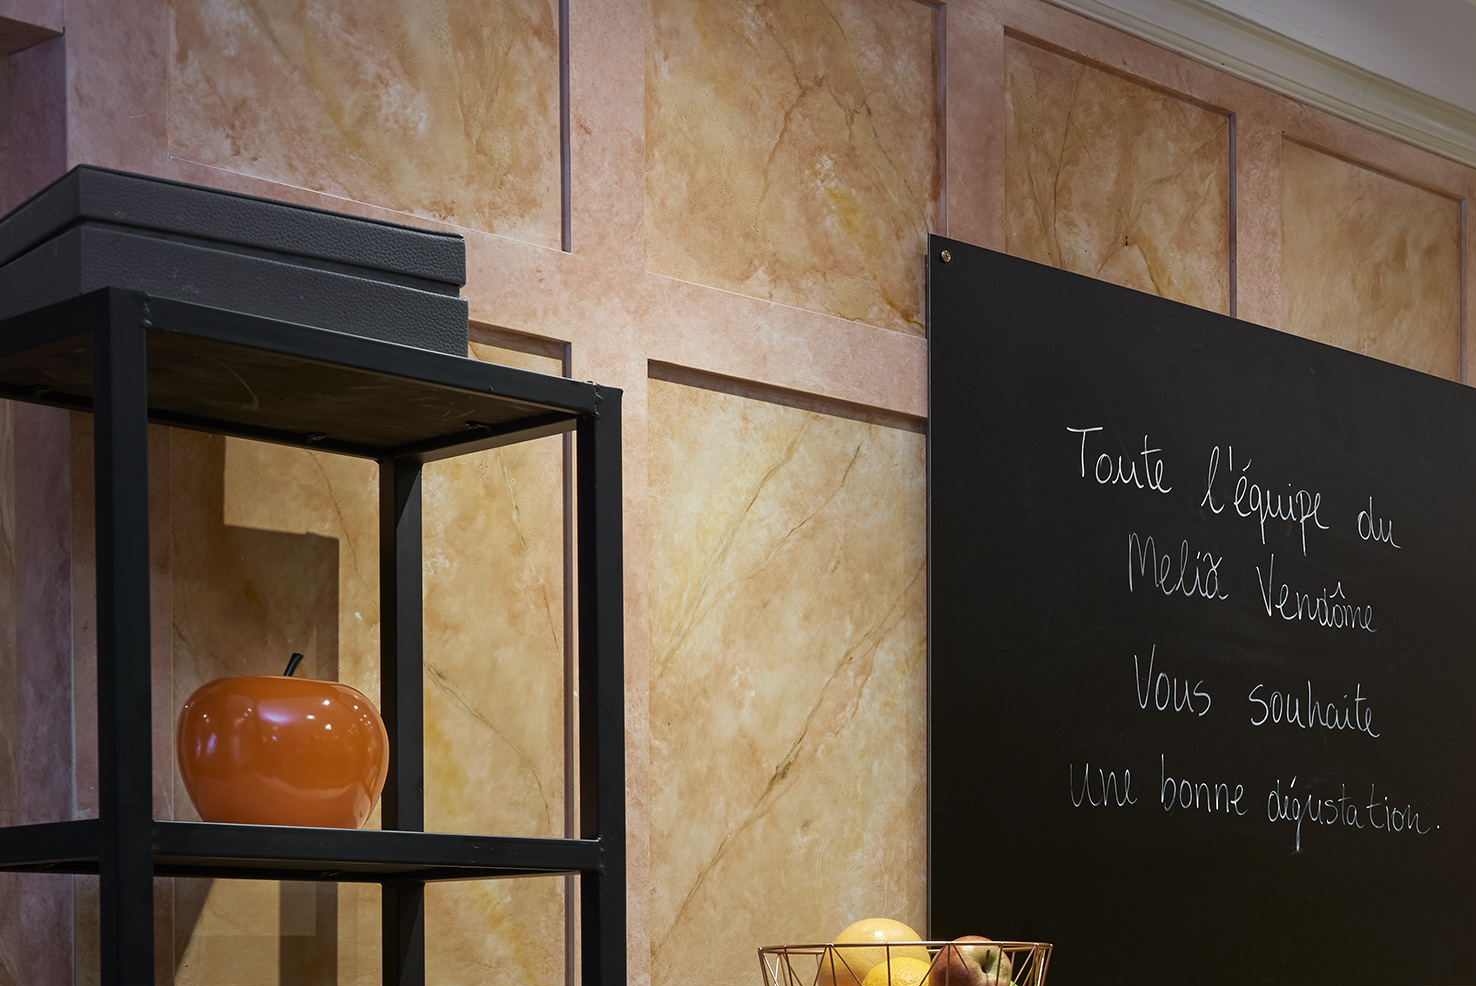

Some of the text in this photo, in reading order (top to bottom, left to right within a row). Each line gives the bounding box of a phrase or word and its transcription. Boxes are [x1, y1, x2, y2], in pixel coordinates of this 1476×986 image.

[1066, 426, 1403, 556] Toute l'équipe du
[1256, 553, 1378, 633] Vendôme
[1134, 643, 1212, 717] Vous
[1160, 753, 1249, 817] bonne
